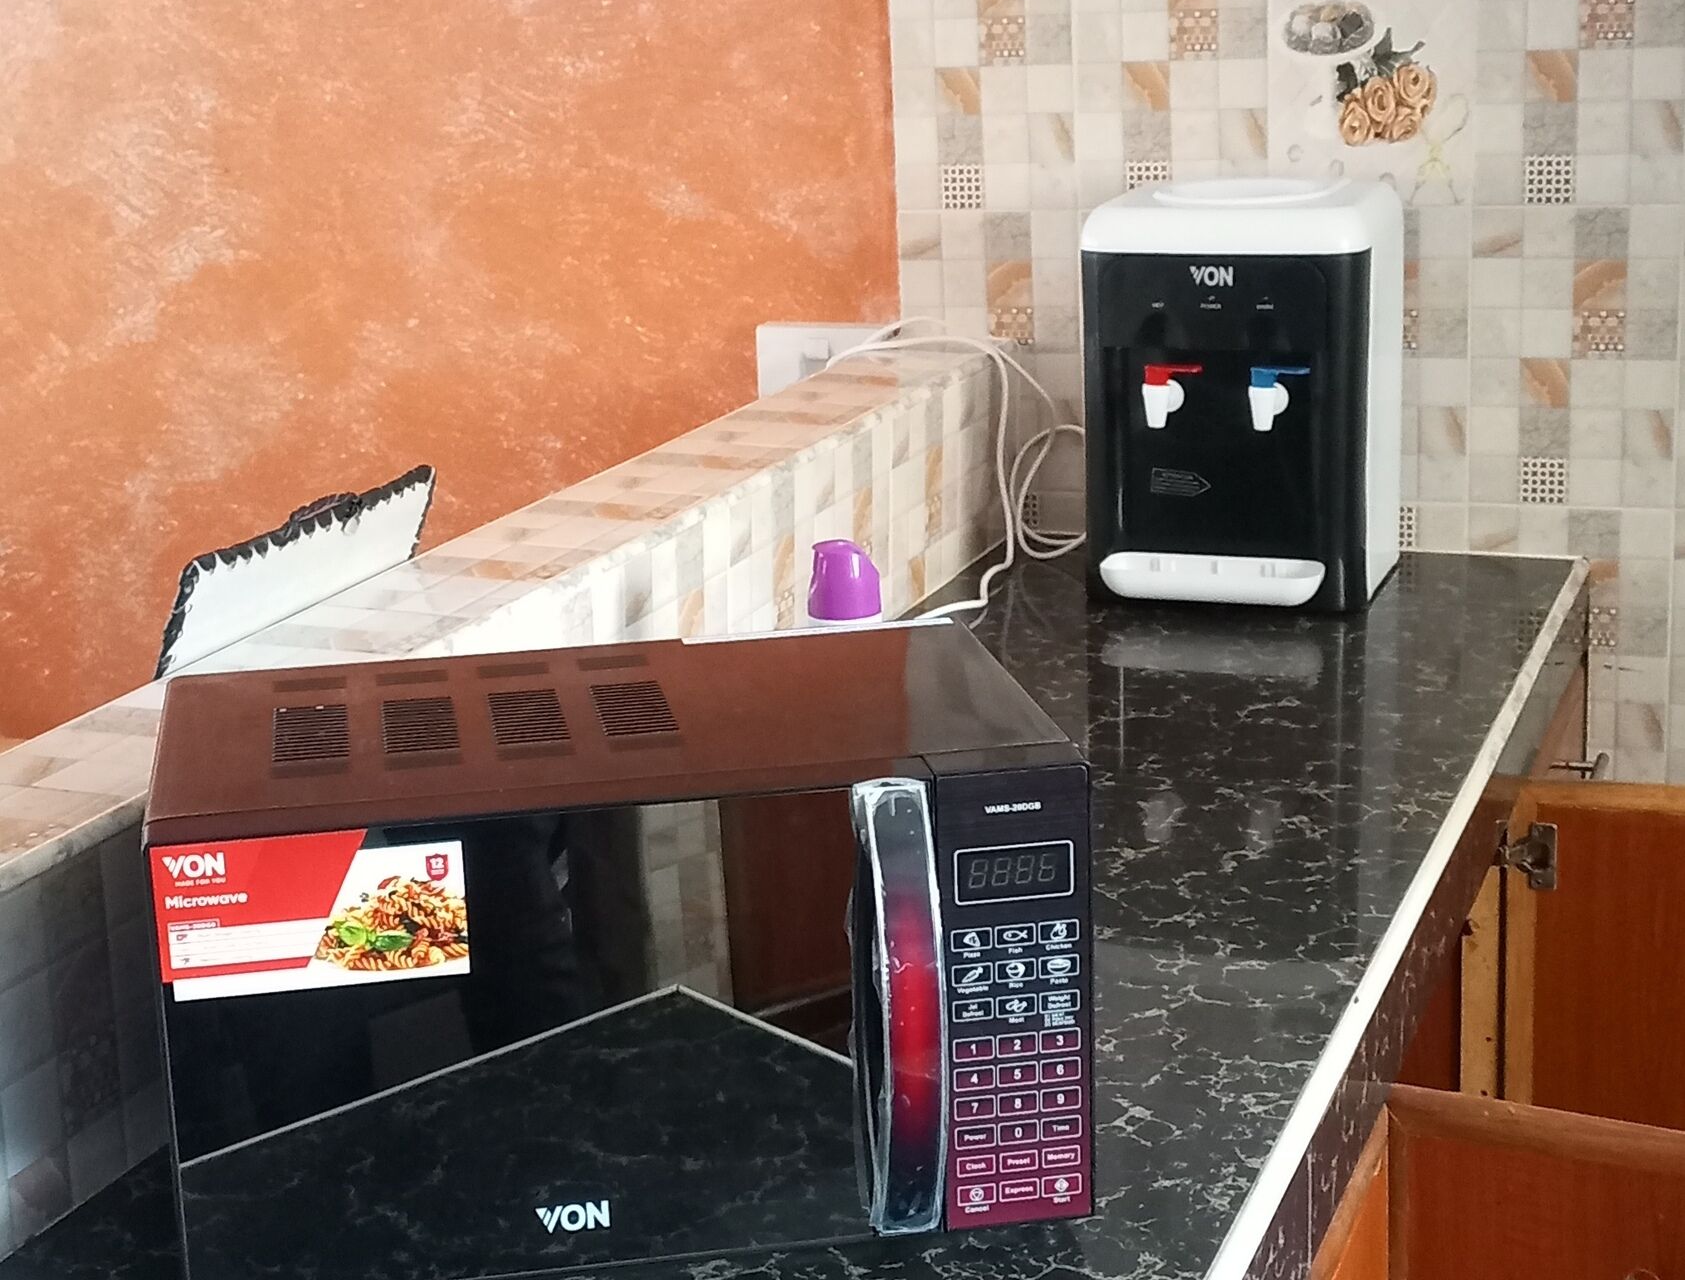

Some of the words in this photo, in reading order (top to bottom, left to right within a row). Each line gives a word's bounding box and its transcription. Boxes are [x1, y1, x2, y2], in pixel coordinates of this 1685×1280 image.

[1189, 266, 1234, 287] VON
[161, 852, 226, 879] VON
[164, 892, 248, 910] Microwave
[1008, 946, 1023, 955] Fish
[1014, 1039, 1021, 1050] 2
[1056, 1035, 1064, 1046] 3
[970, 1044, 977, 1054] 1
[1014, 1069, 1021, 1079] 5
[1056, 1064, 1064, 1075] 6
[970, 1073, 979, 1084] 4
[1014, 1098, 1022, 1109] 8
[1057, 1094, 1065, 1105] 9
[971, 1103, 979, 1113] 7
[1014, 1127, 1022, 1138] 0
[1052, 1124, 1070, 1132] Time
[964, 1133, 987, 1141] Power
[1007, 1157, 1030, 1166] Preset
[1047, 1151, 1076, 1162] Memory
[966, 1162, 987, 1170] Clock
[1004, 1186, 1034, 1195] Express
[965, 1205, 990, 1214] Cancel
[534, 1199, 611, 1234] VON
